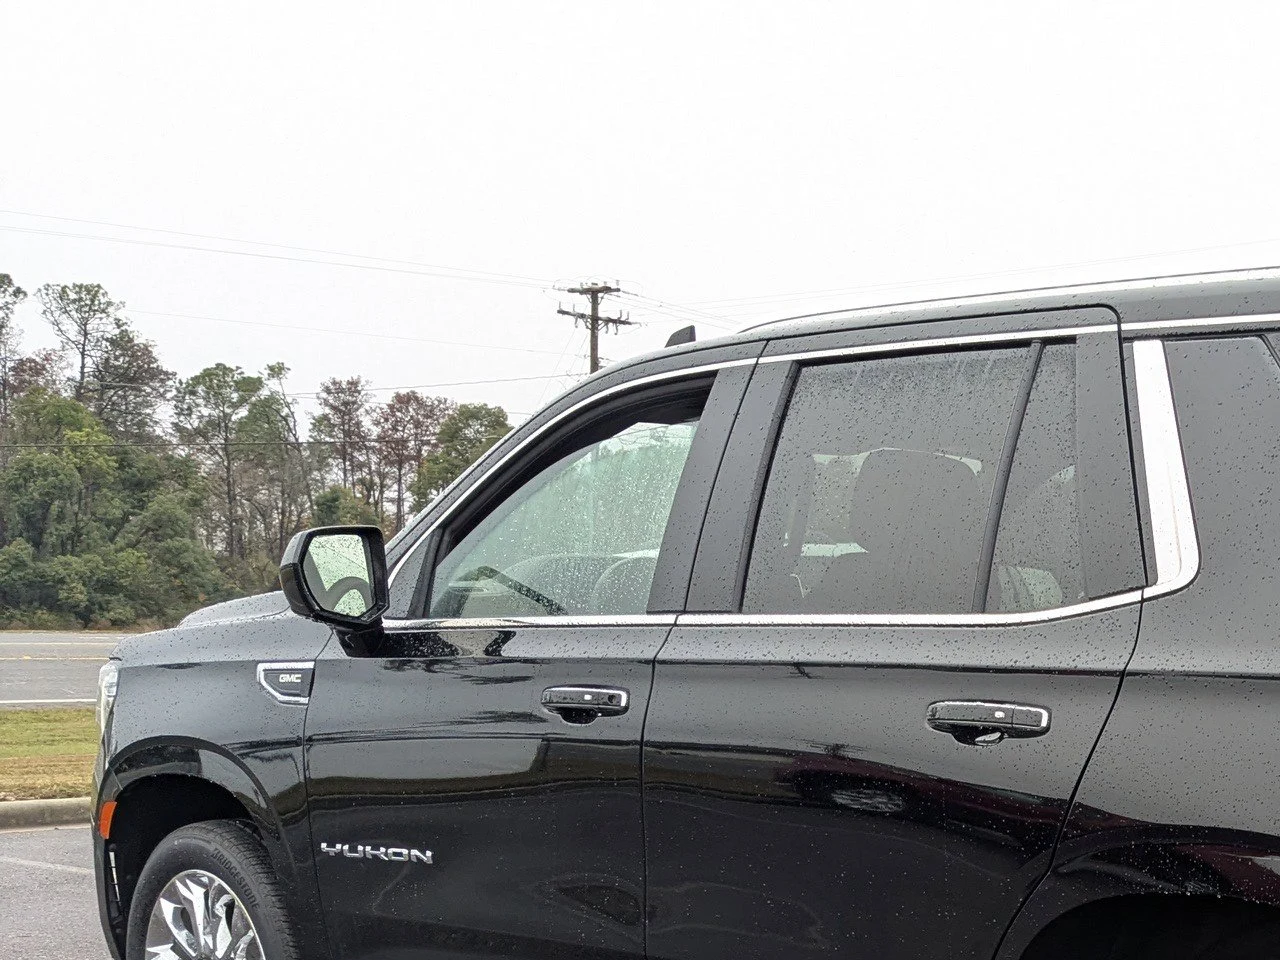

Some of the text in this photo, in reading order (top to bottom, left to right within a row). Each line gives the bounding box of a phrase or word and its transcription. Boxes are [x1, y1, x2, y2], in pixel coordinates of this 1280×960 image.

[279, 674, 302, 683] GMC
[320, 842, 434, 864] YUKON
[211, 847, 261, 912] BRIDGESTONE
